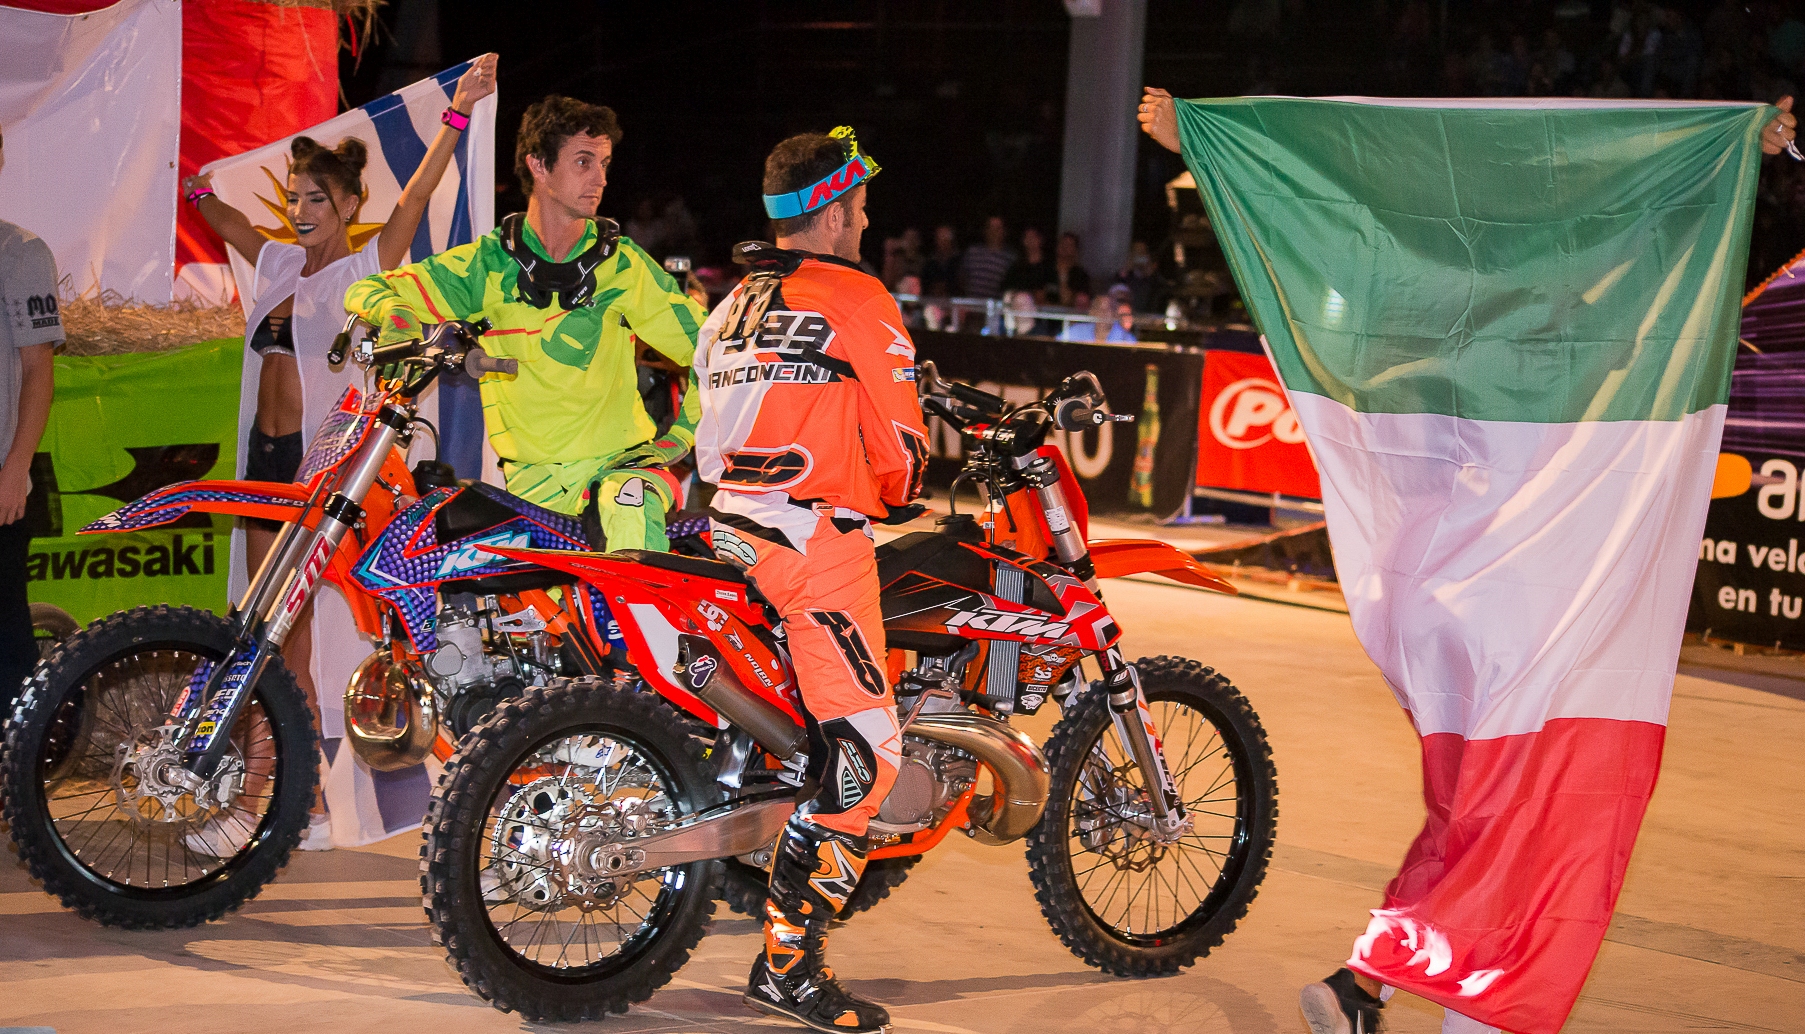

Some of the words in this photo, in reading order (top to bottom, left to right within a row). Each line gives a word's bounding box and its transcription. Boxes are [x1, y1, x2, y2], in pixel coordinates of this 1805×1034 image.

[1718, 586, 1757, 613] en
[1770, 588, 1803, 619] tu
[945, 609, 1071, 639] KTM
[744, 653, 774, 688] NOLAN
